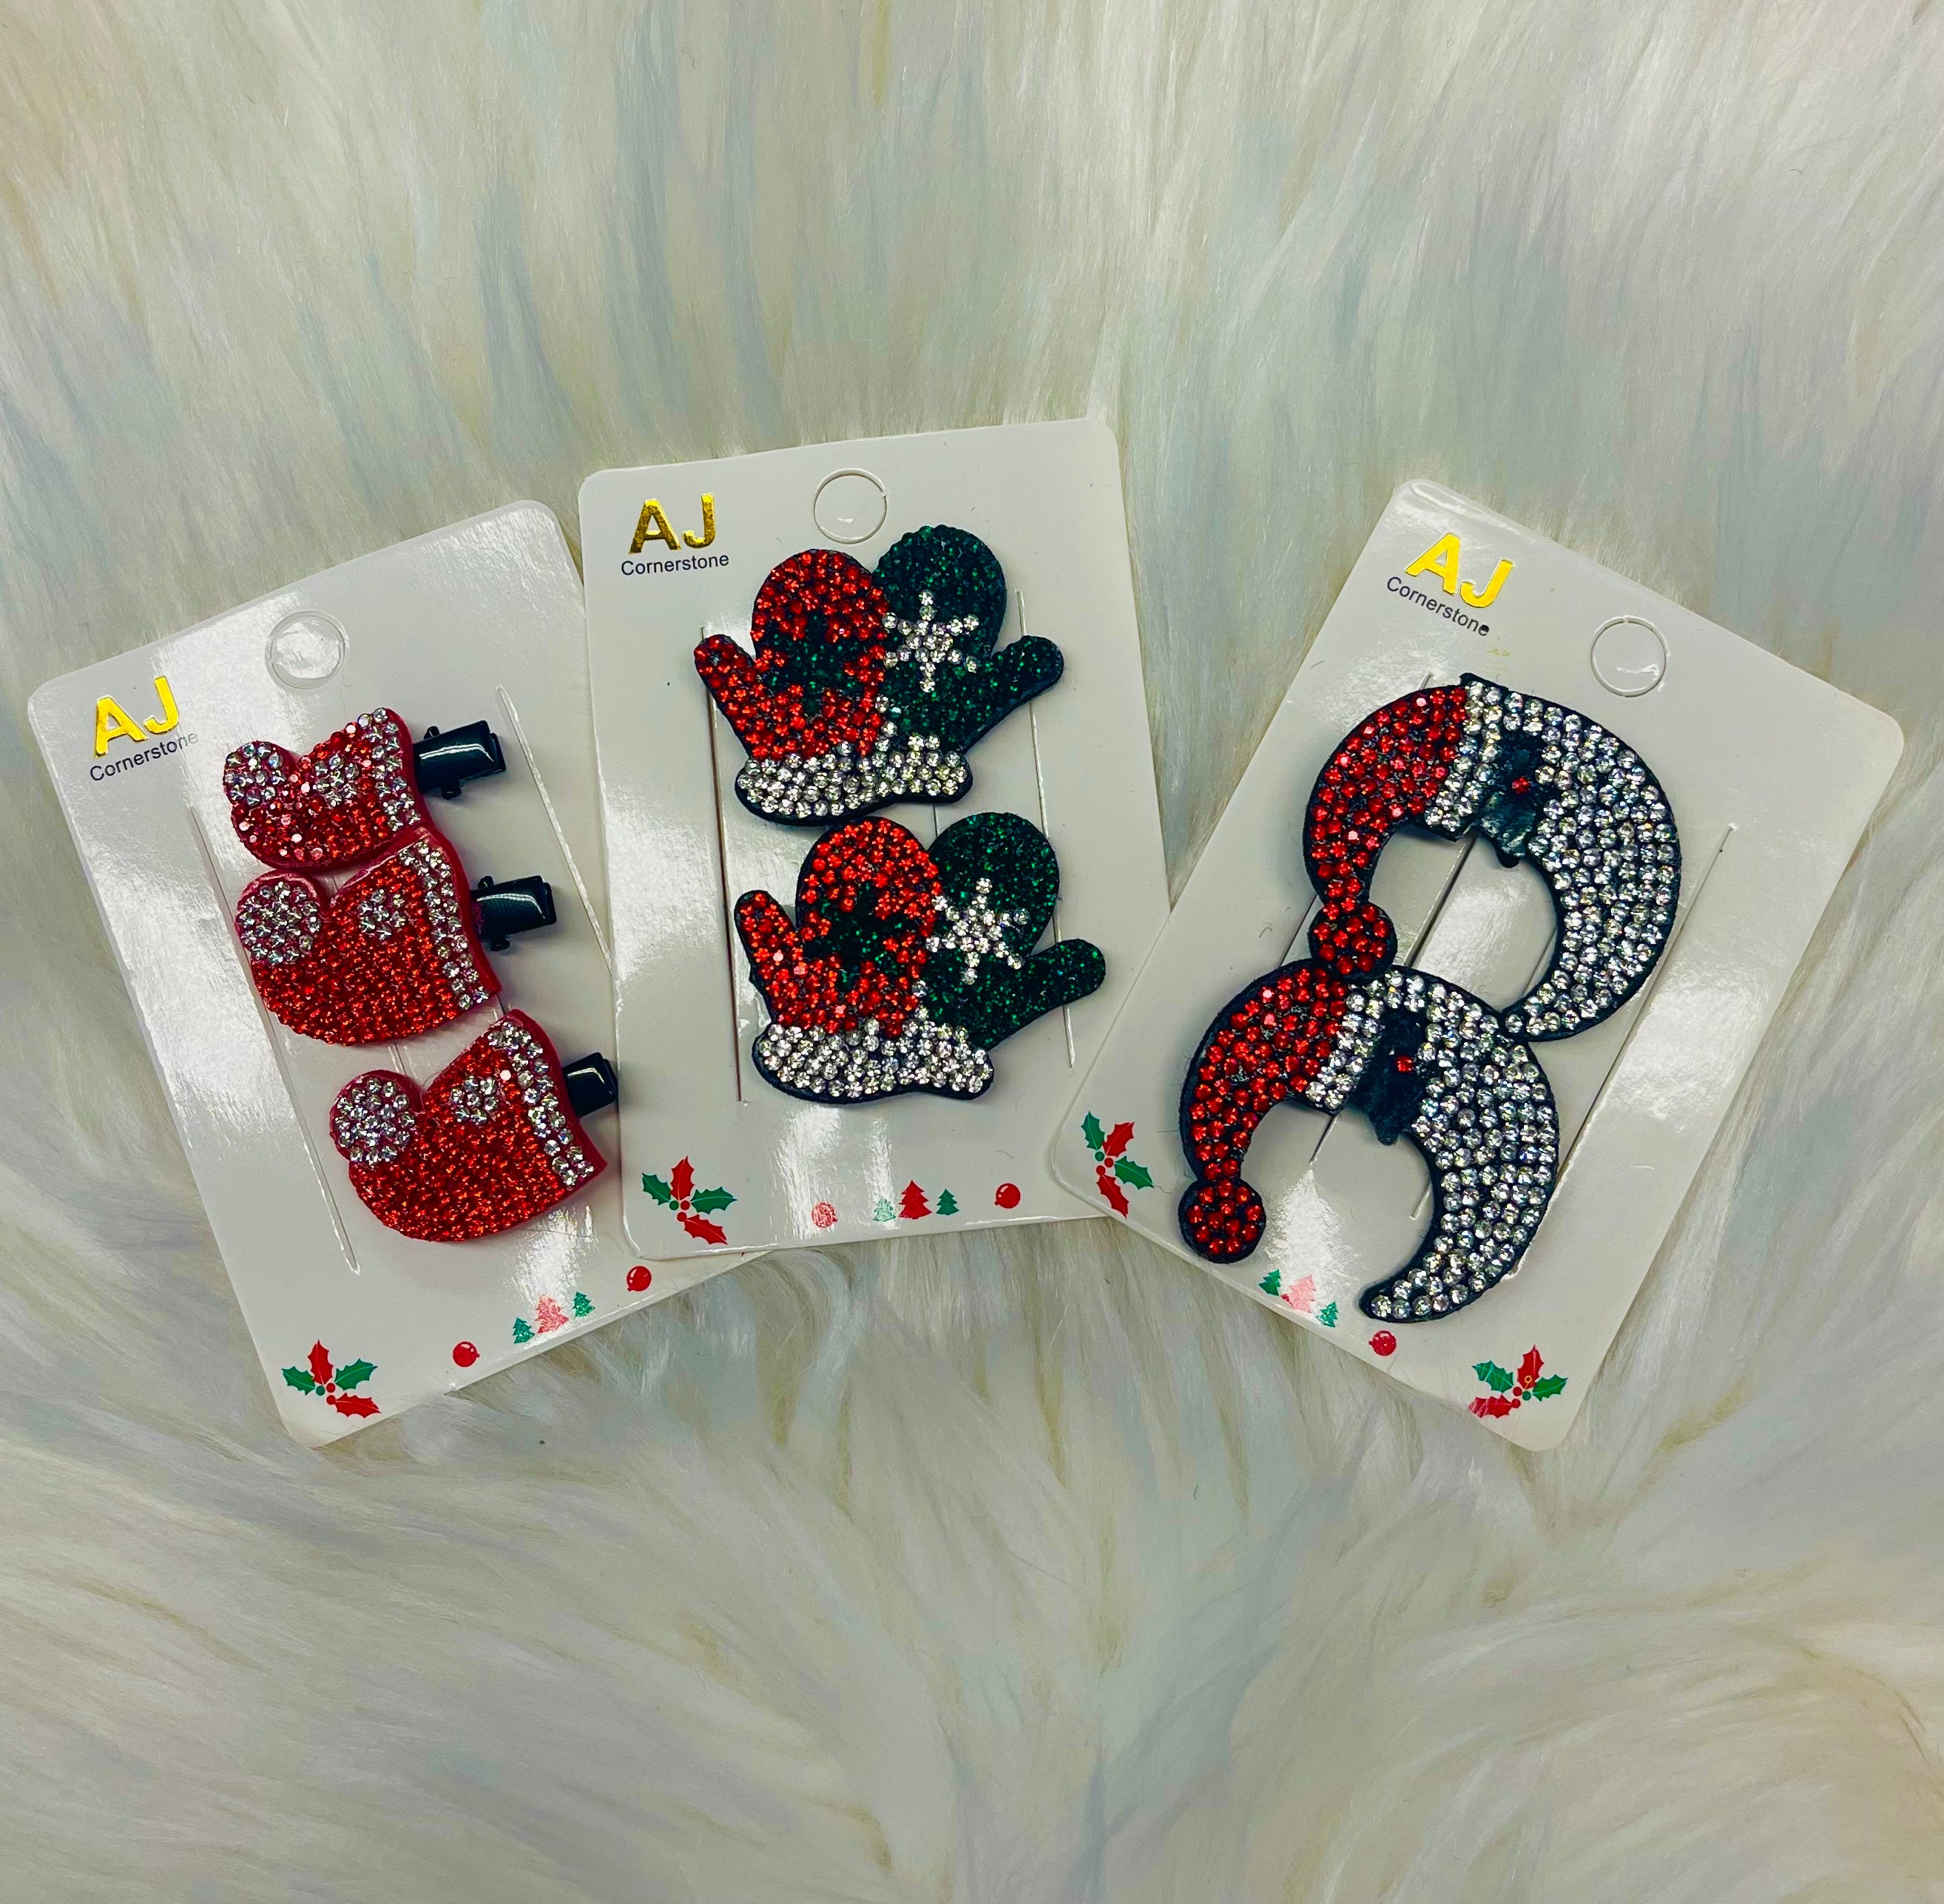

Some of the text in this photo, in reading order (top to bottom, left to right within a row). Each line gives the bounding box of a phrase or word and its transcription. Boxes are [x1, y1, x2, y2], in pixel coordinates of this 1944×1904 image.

[629, 493, 717, 554] AJ
[621, 553, 729, 575] Cornerstone
[1405, 532, 1514, 609] AJ
[1386, 575, 1490, 637] Cornerstone
[92, 675, 180, 758] AJ
[90, 729, 199, 781] Cornerstone
